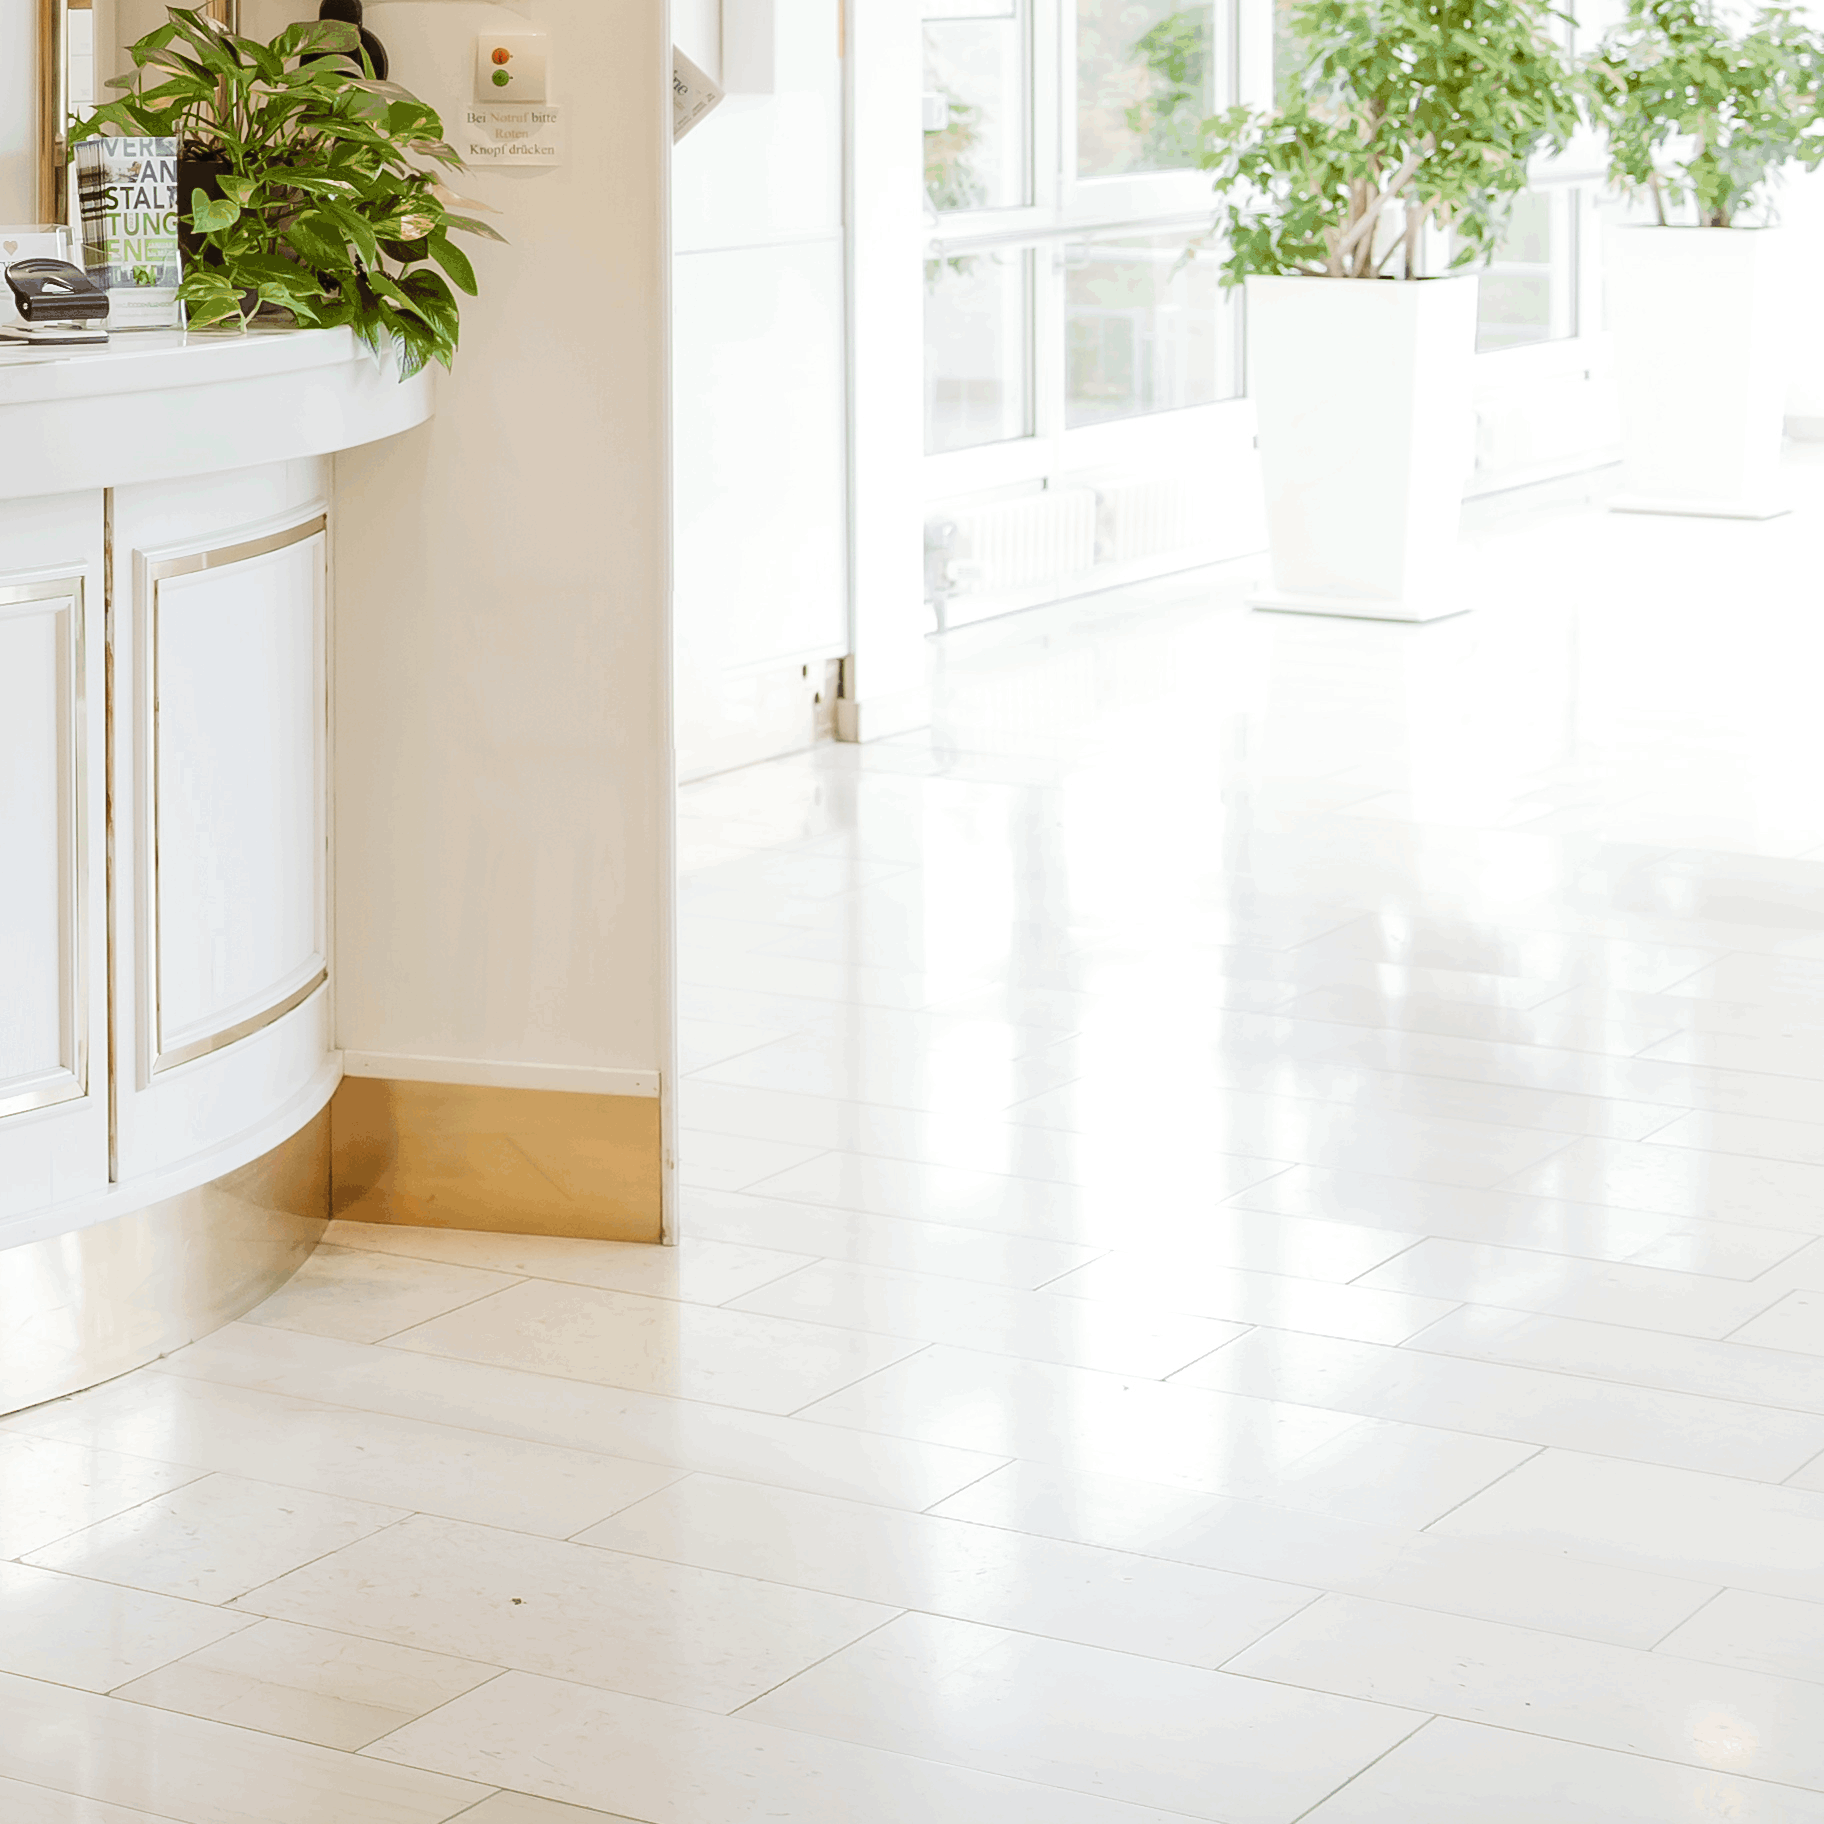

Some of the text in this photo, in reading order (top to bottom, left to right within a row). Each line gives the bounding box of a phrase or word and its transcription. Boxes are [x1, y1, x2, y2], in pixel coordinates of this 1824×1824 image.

[466, 112, 557, 124] Bei Notruf bitte
[494, 128, 529, 139] Roten
[102, 138, 154, 158] VER
[470, 144, 555, 157] Knopf drücken
[140, 160, 178, 184] AN
[106, 212, 178, 236] TUNG
